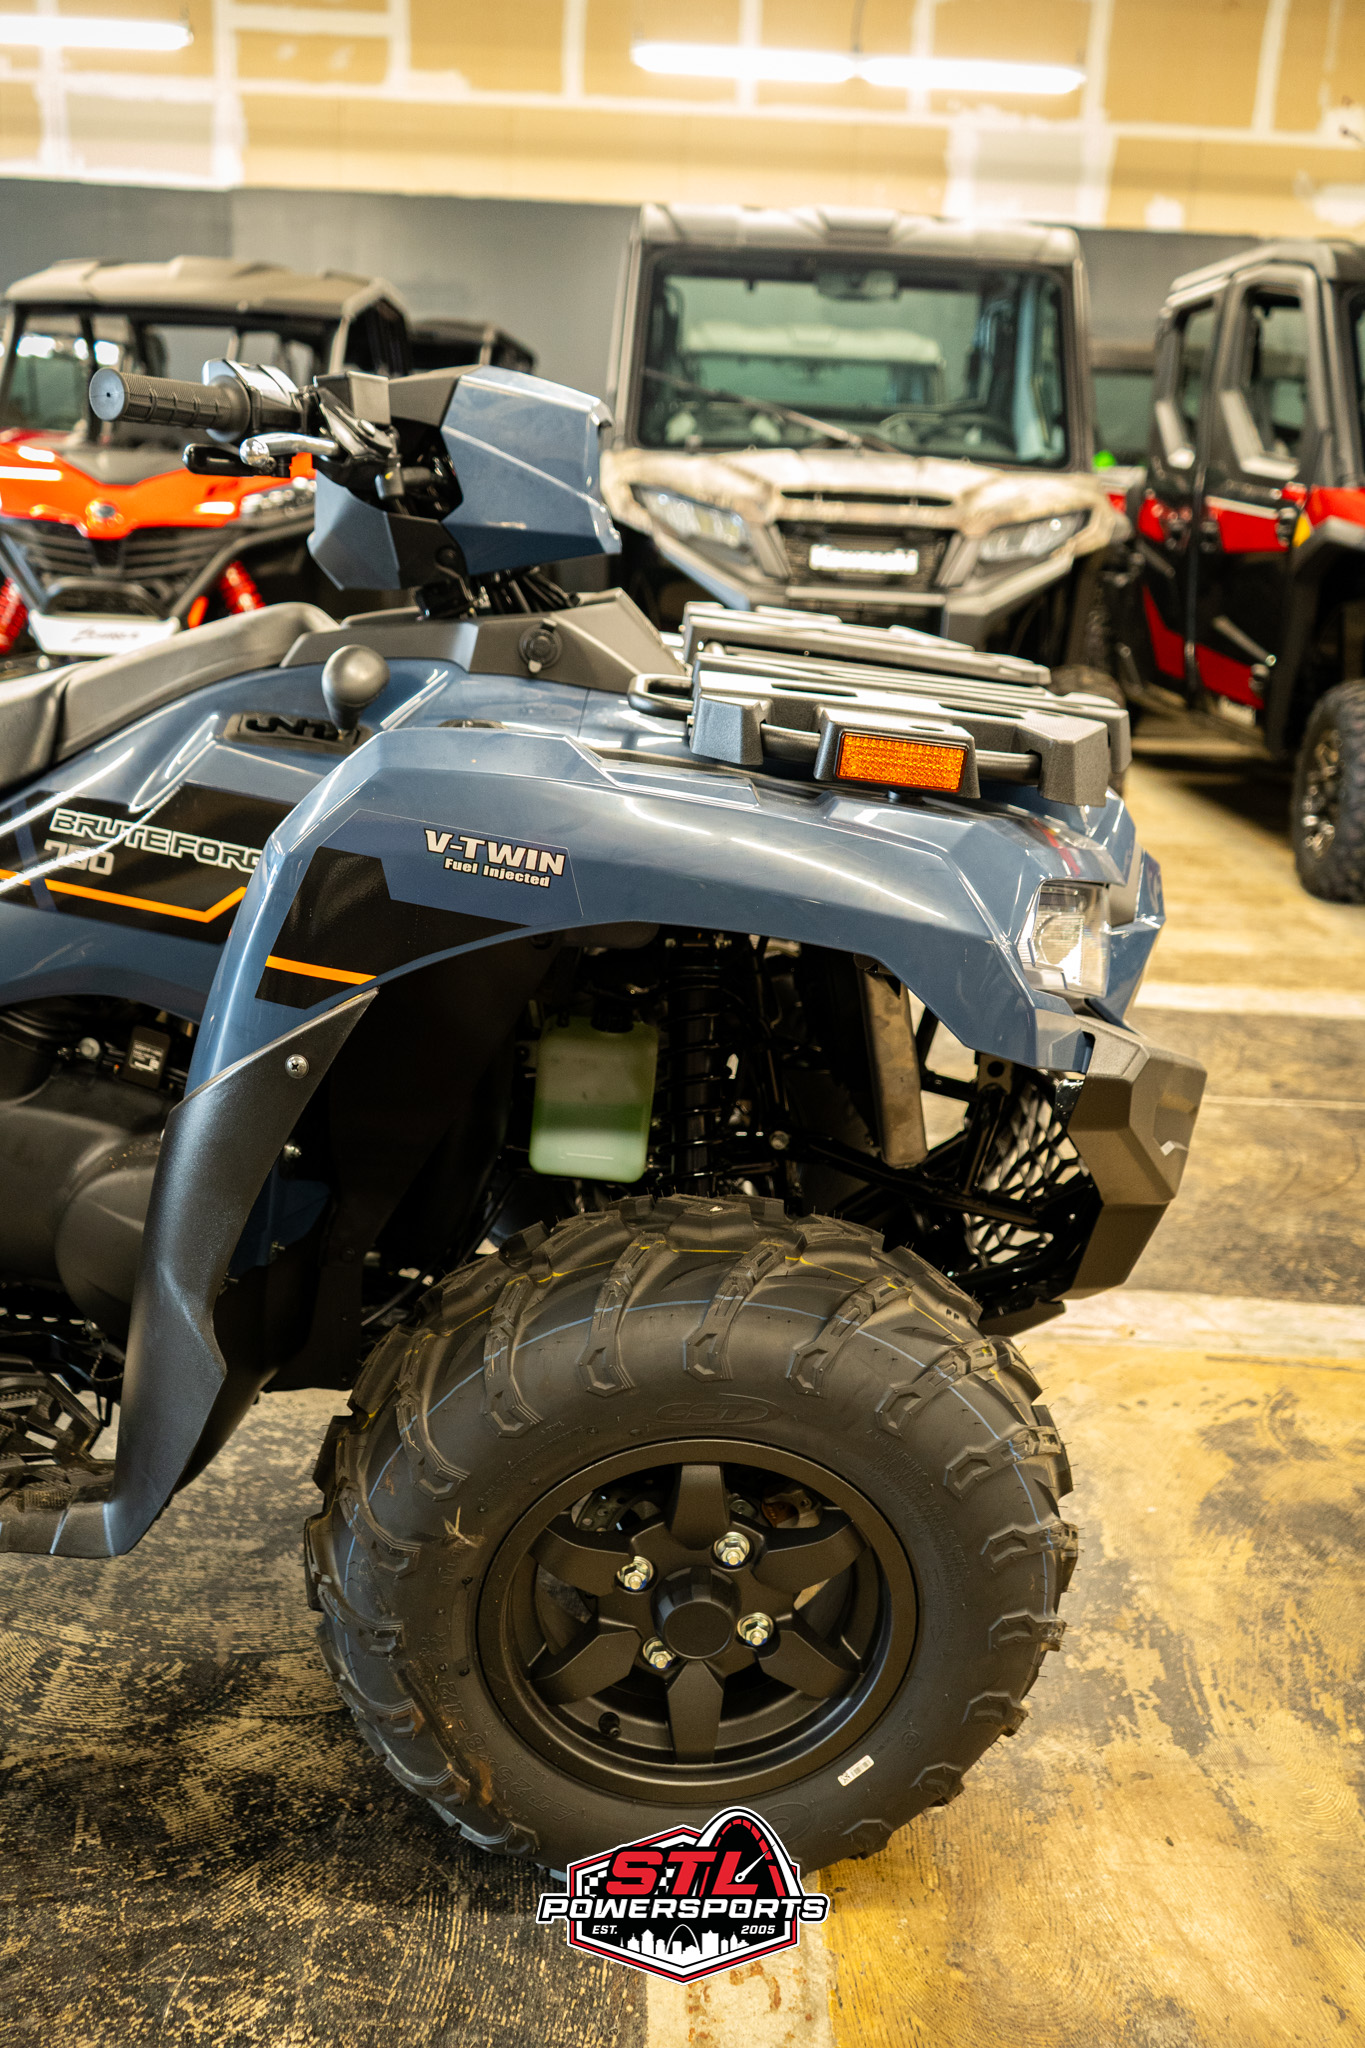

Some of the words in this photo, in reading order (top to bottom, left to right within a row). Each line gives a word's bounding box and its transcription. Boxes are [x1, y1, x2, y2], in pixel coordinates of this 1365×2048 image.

[49, 808, 172, 855] BRUTE
[424, 828, 566, 876] V-TWIN
[44, 838, 115, 876] 750
[443, 857, 479, 874] Fuel
[482, 865, 551, 888] Injected
